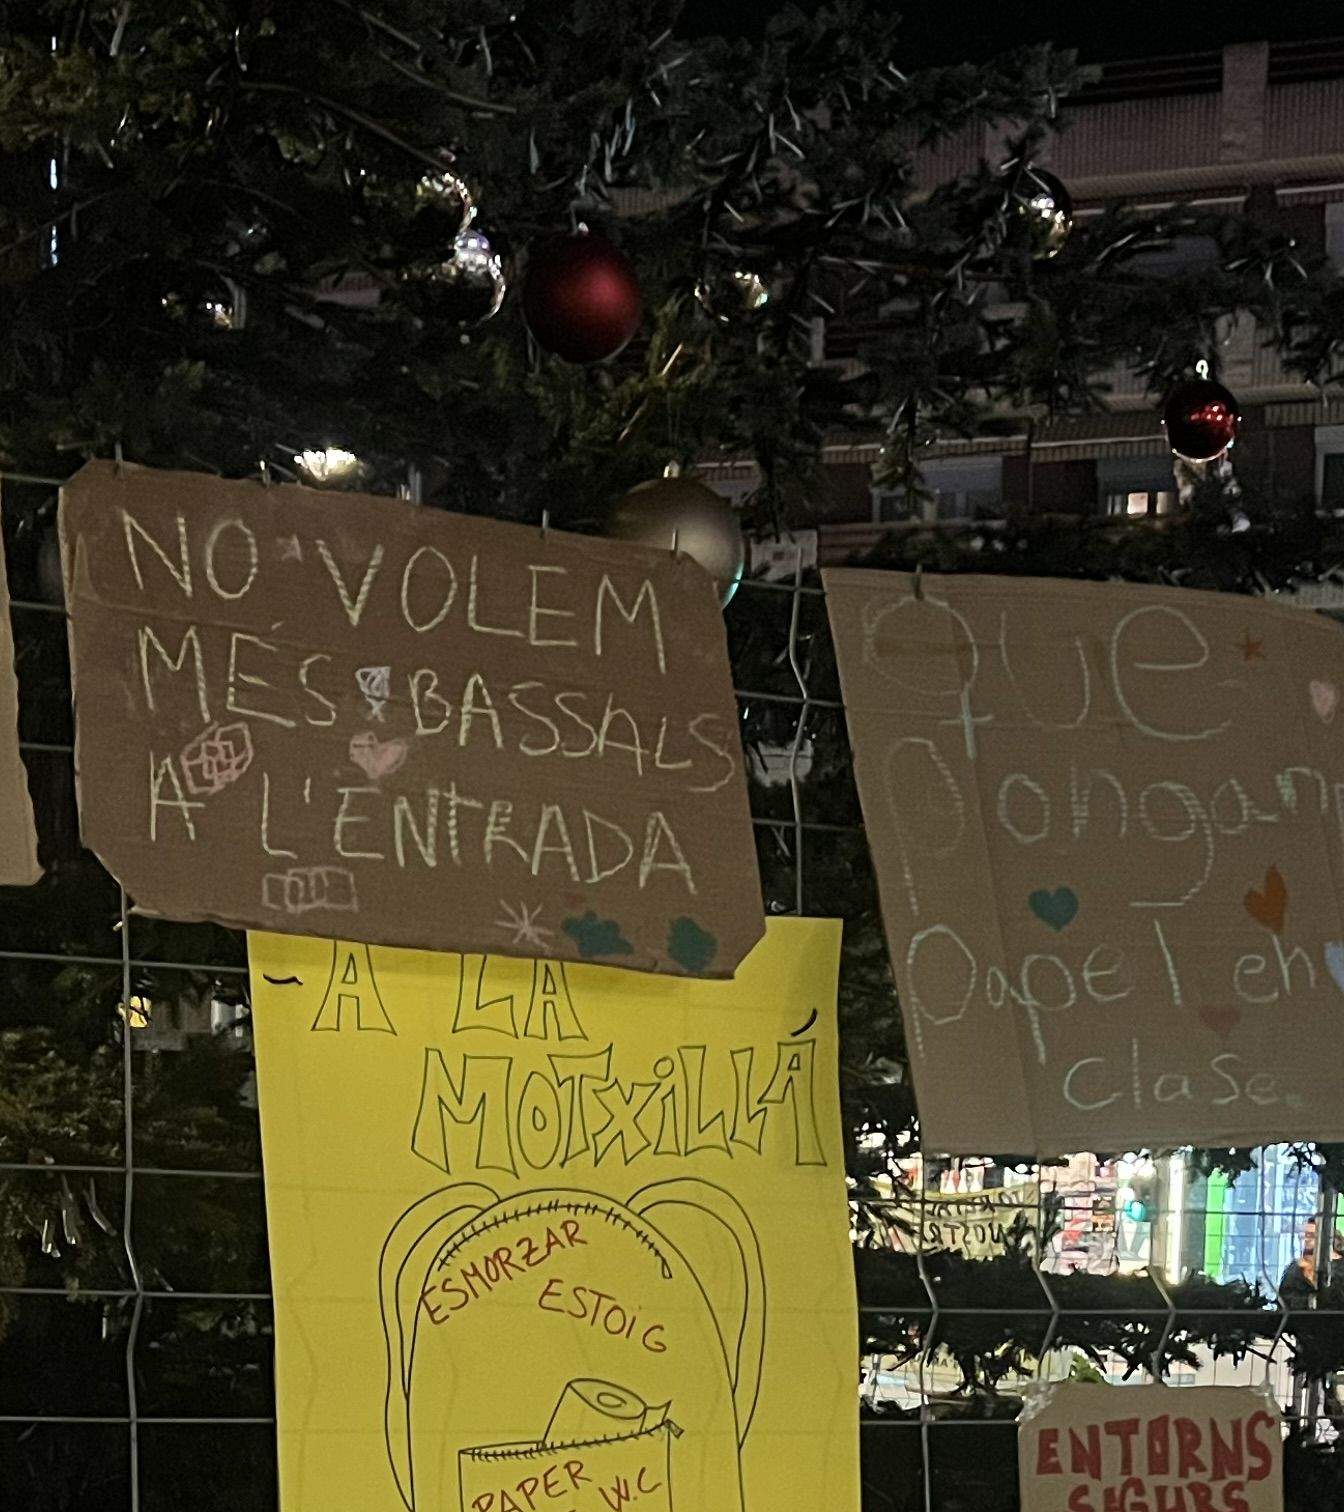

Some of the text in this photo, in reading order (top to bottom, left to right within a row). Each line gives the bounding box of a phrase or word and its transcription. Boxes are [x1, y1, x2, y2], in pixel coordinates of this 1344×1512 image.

[118, 508, 667, 675] NO VOLEM
[409, 666, 736, 793] BASSALS
[149, 749, 700, 897] A L'ENTRADA
[311, 940, 589, 1042] A LA
[421, 1217, 589, 1328] ESMORZAR
[536, 1277, 669, 1356] ESTOIG
[1035, 1409, 1279, 1484] ENTORNS
